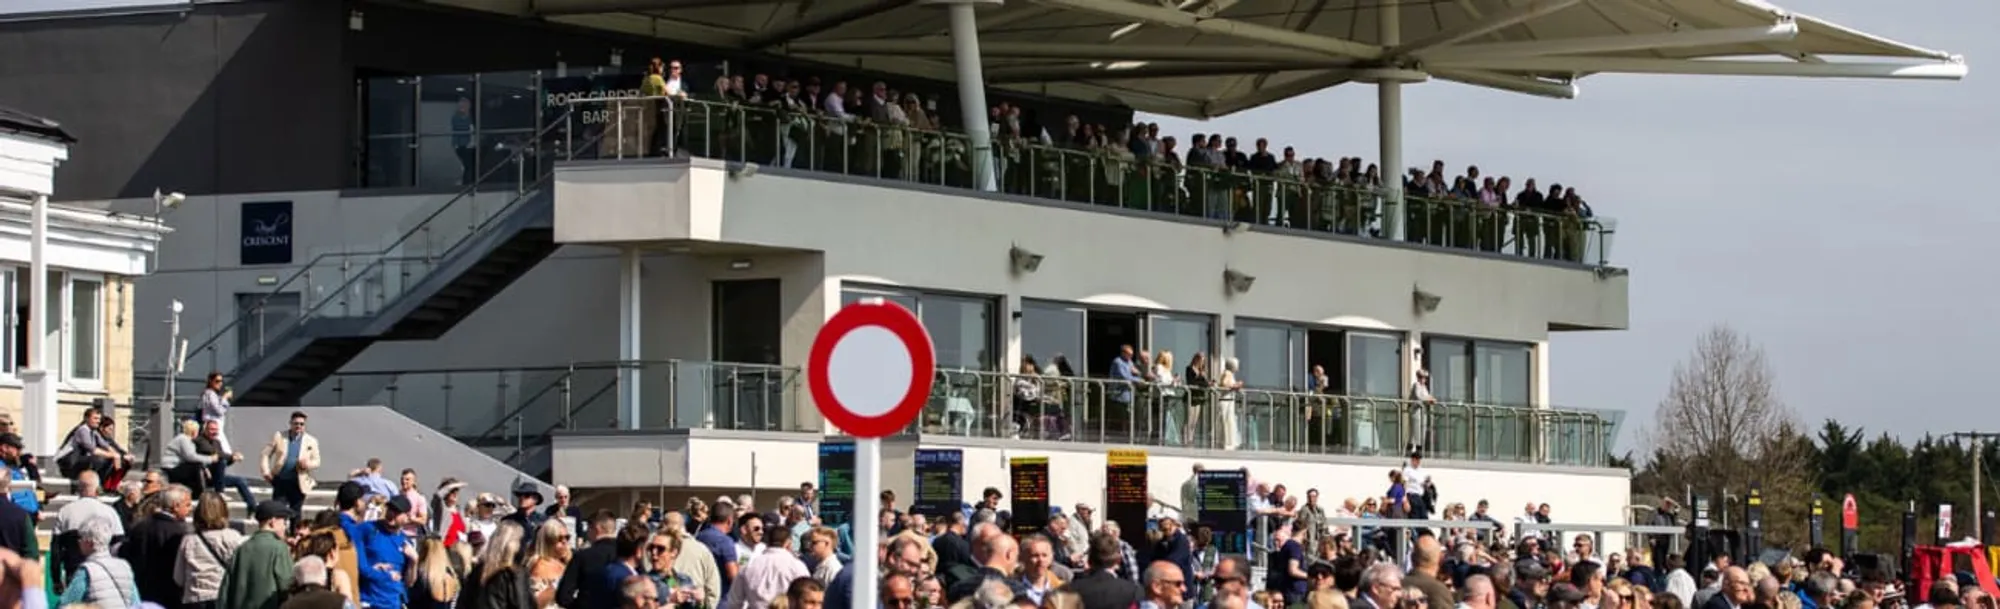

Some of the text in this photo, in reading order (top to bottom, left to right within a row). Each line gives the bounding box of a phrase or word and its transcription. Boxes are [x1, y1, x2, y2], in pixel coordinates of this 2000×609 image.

[547, 91, 586, 107] ROOF
[582, 110, 609, 124] BAR
[243, 236, 288, 246] CRESCENT
